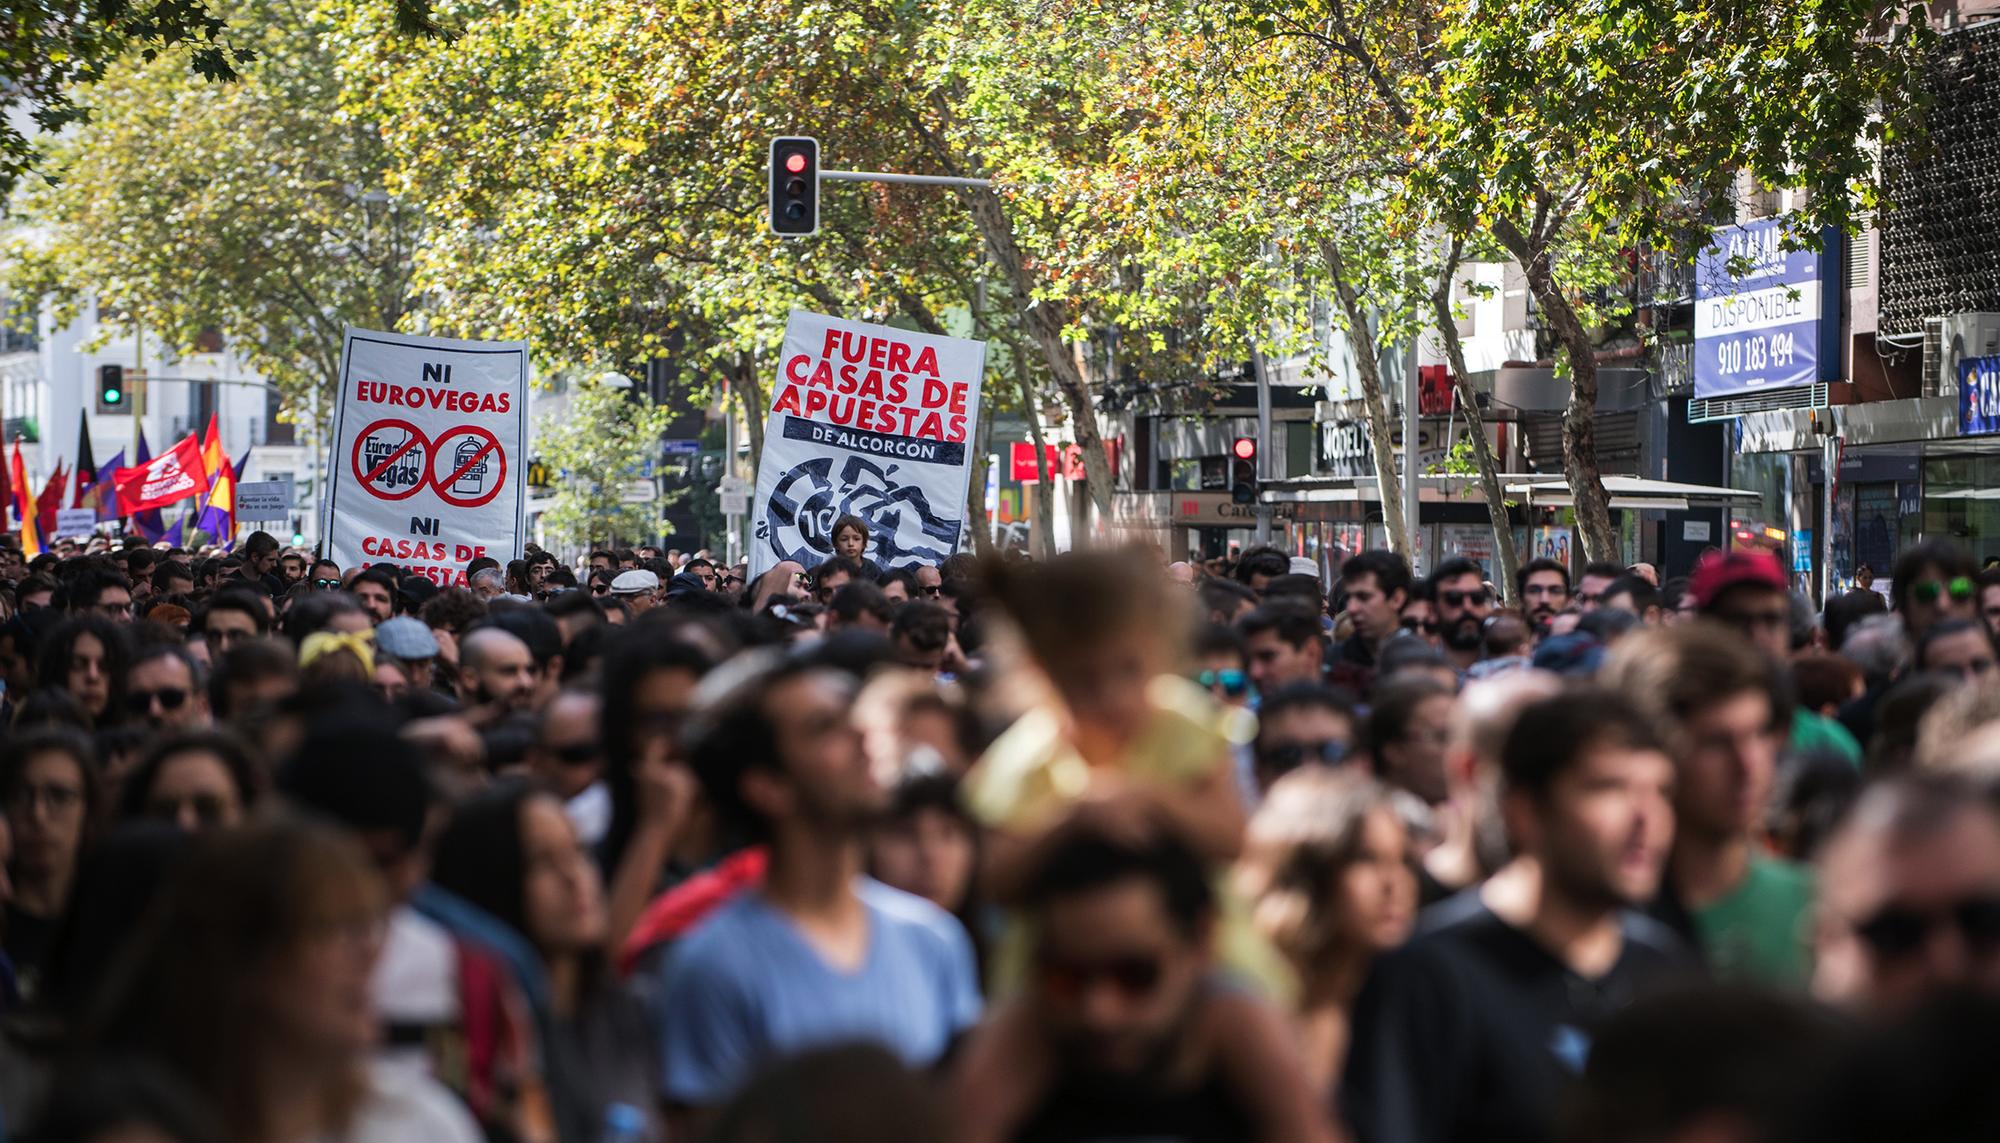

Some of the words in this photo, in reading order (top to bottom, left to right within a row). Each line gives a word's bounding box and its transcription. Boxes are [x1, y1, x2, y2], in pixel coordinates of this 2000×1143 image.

[822, 328, 940, 378] FUERA
[1718, 339, 1741, 375] 910
[1745, 335, 1766, 372] 183
[1770, 331, 1794, 368] 494
[422, 362, 451, 384] NI
[786, 354, 908, 404] CASAS
[921, 378, 968, 415] DE
[356, 381, 510, 413] EUROVEGAS
[772, 384, 968, 444] APUESTAS
[812, 426, 833, 443] DE
[837, 431, 936, 460] ALCORCÓN
[410, 516, 440, 536] NI
[362, 536, 447, 561] CASAS
[455, 544, 486, 563] DE
